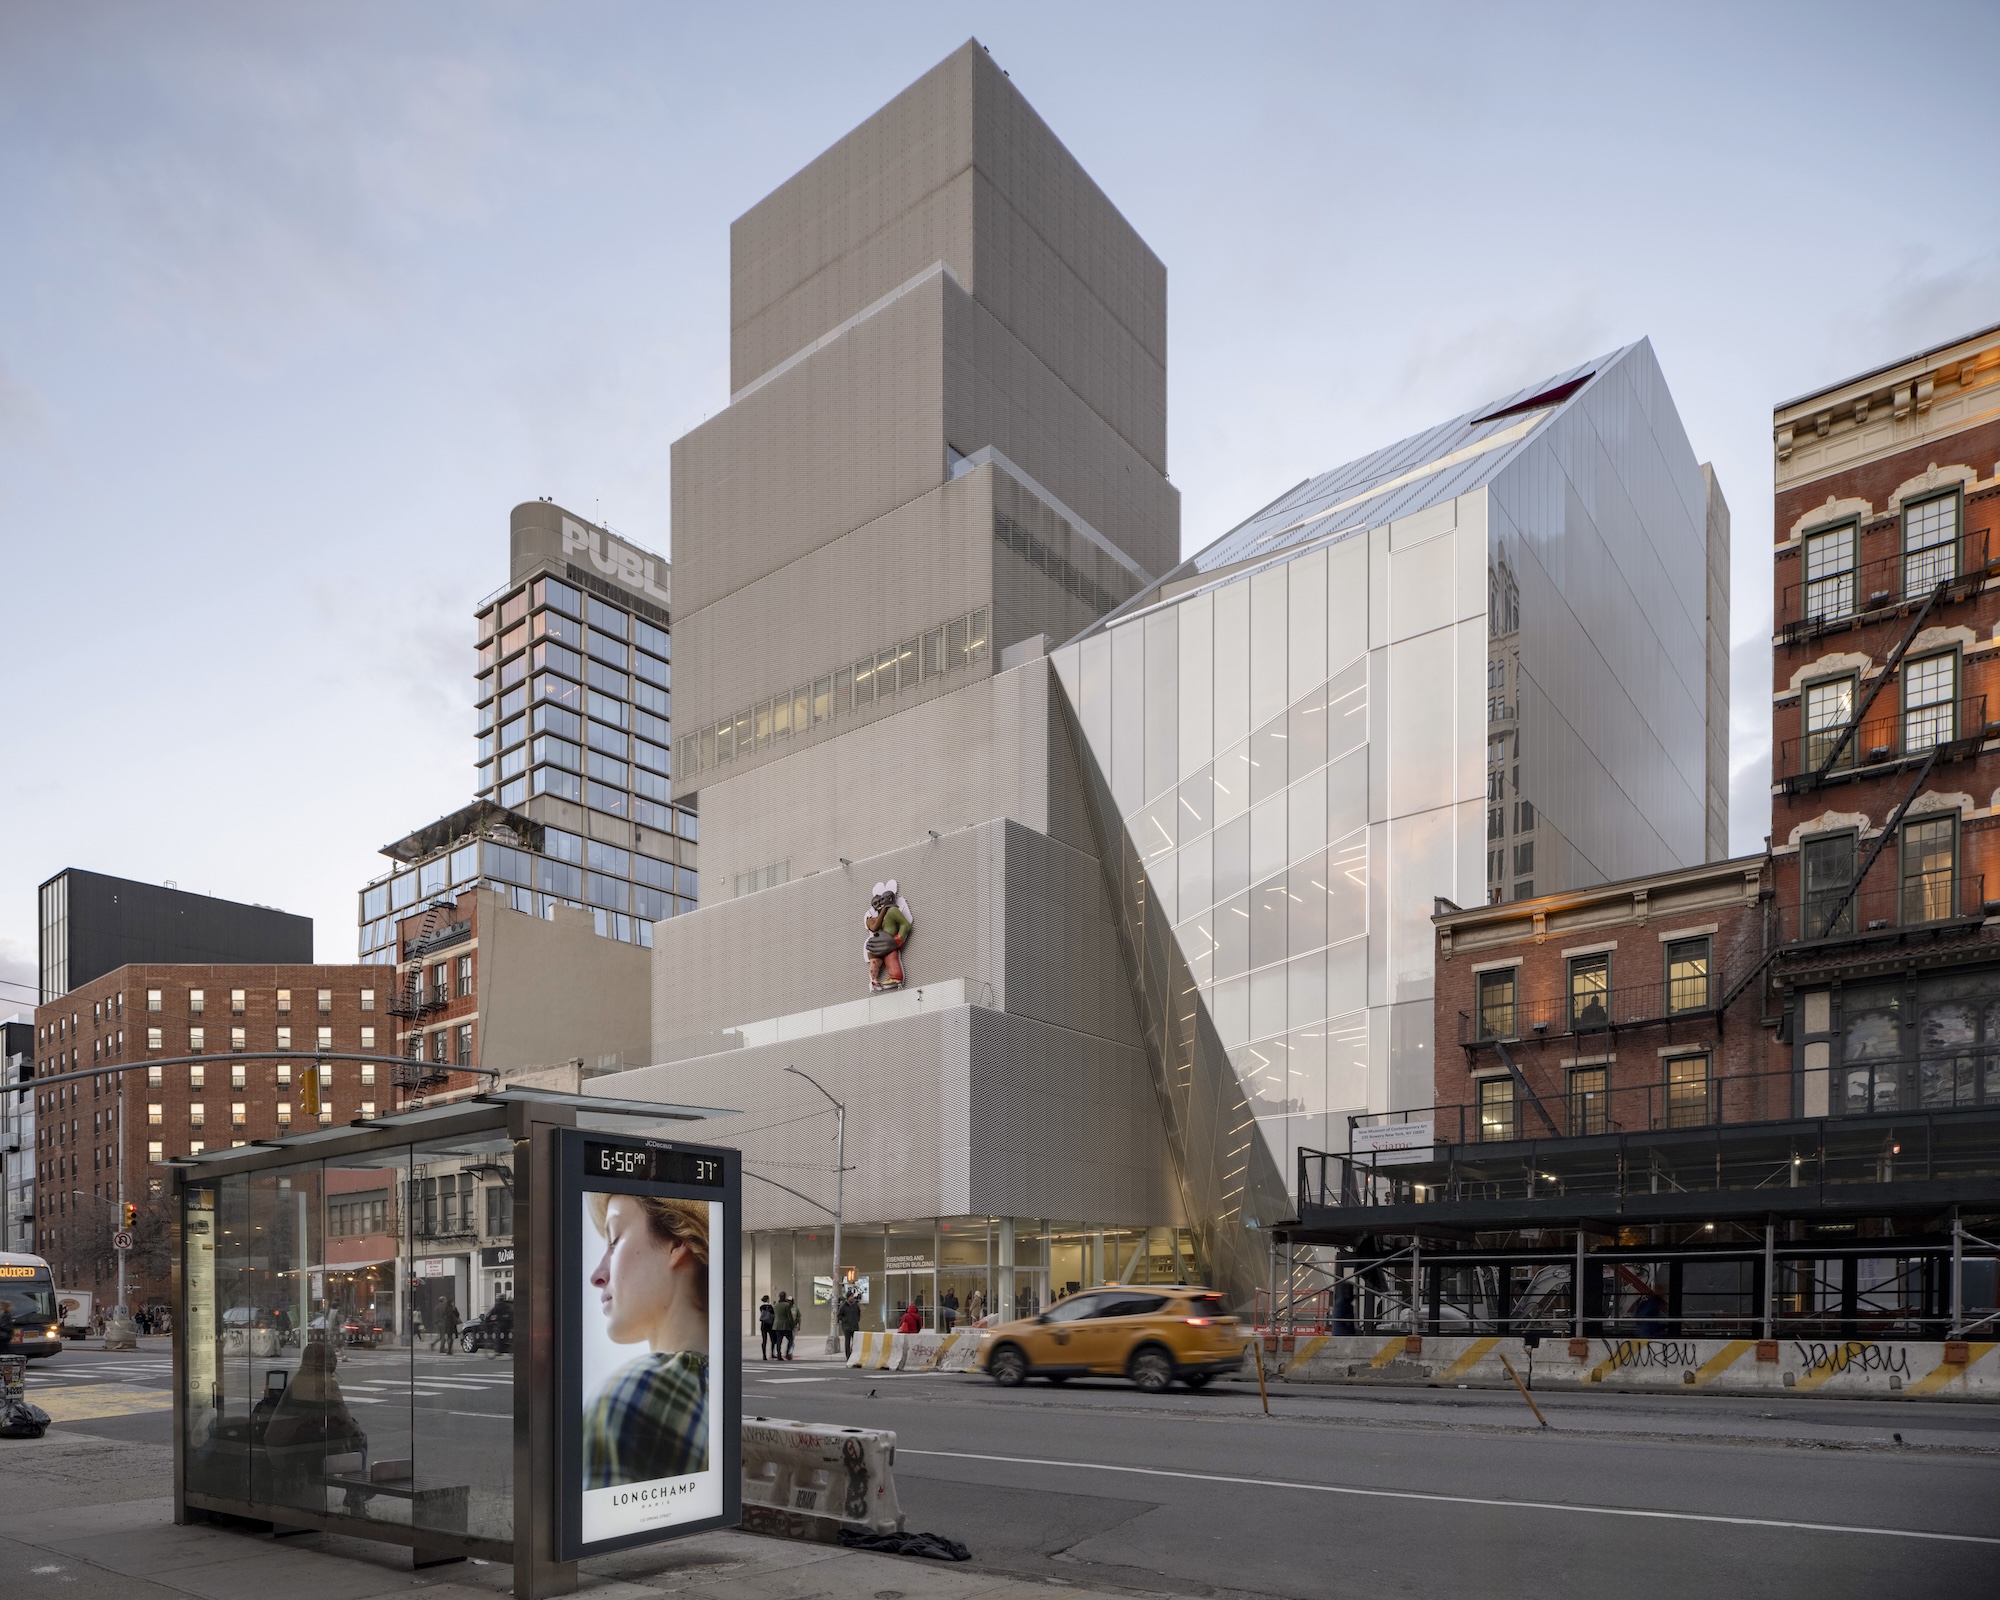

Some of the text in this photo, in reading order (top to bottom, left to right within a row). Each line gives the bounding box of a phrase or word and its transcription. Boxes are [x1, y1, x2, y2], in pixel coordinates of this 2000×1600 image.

[645, 1140, 673, 1150] JCDecaux
[1372, 1141, 1413, 1151] Sciame
[911, 1260, 935, 1268] BUILDING
[613, 1482, 696, 1506] LONGCHAMP
[641, 1500, 670, 1509] PARIS
